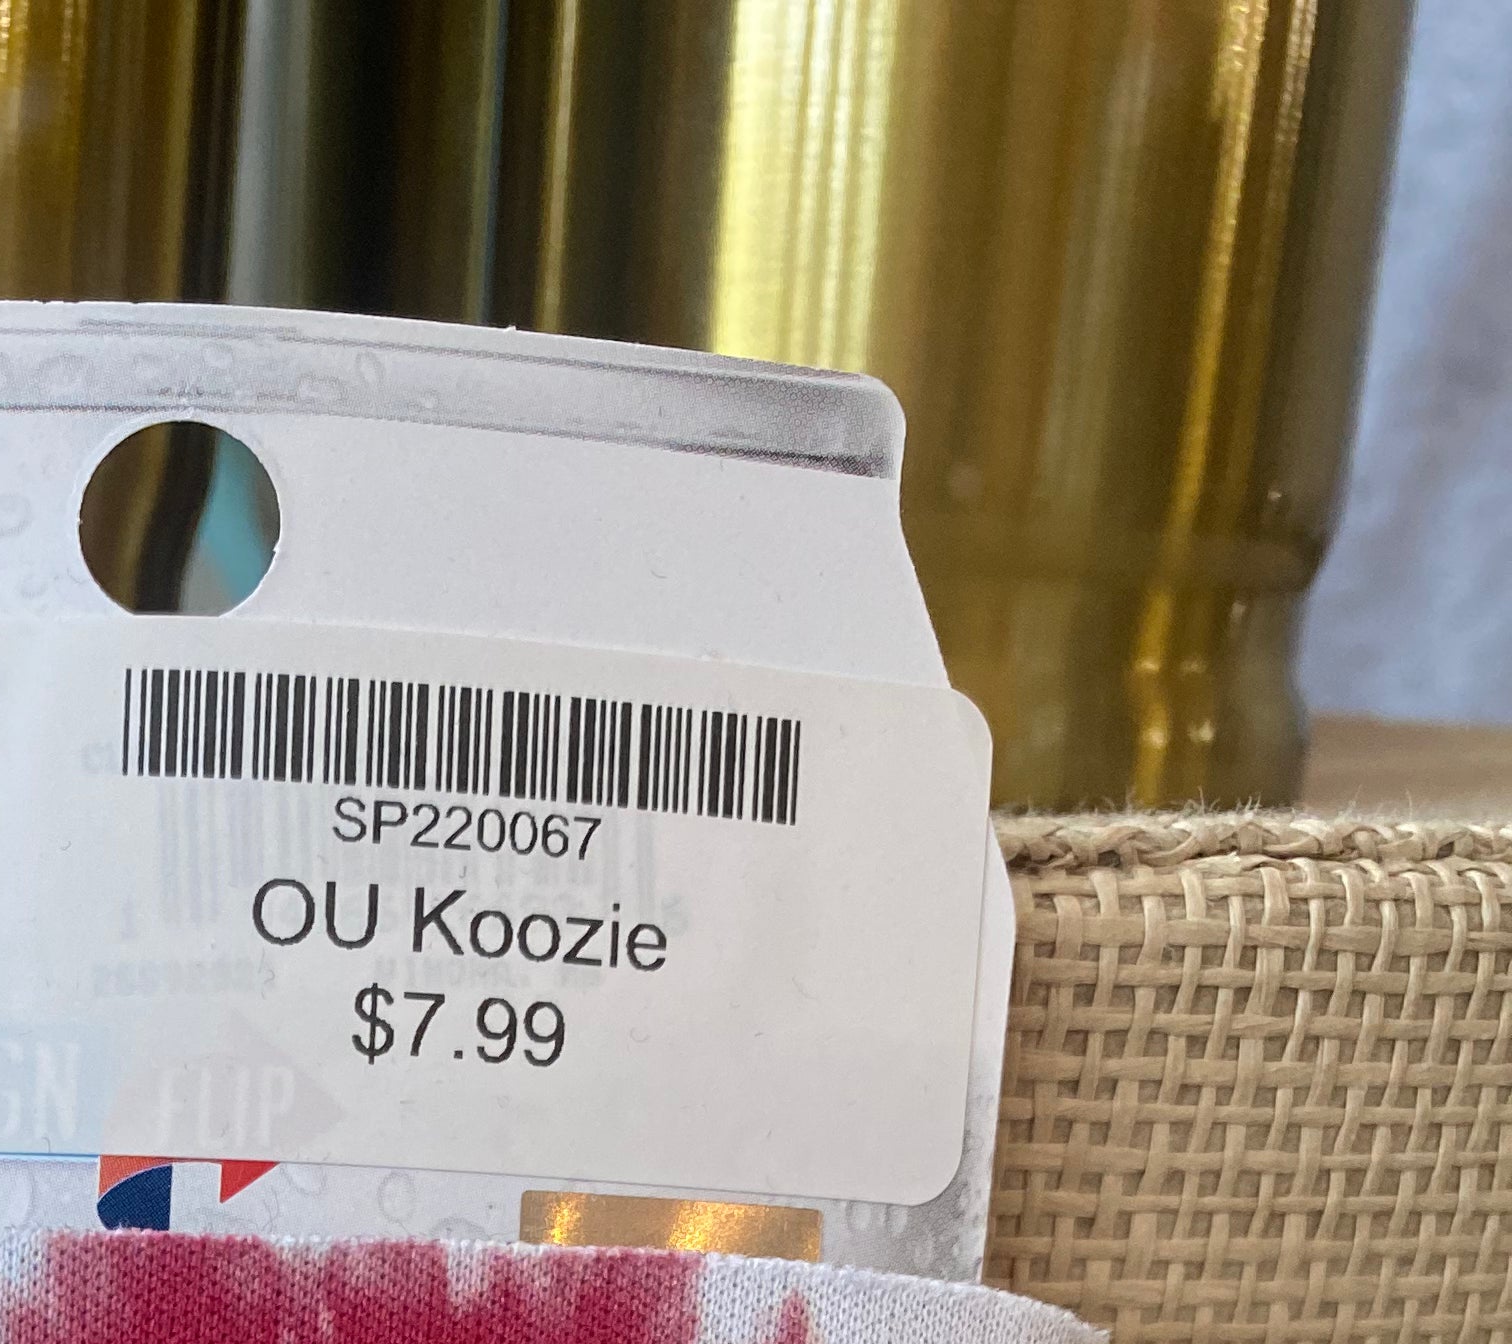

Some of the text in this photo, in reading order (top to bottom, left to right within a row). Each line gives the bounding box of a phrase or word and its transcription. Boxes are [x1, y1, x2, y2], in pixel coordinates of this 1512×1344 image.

[332, 796, 602, 860] SP220067
[252, 878, 667, 972] OU Koozie
[352, 982, 565, 1067] $7.99
